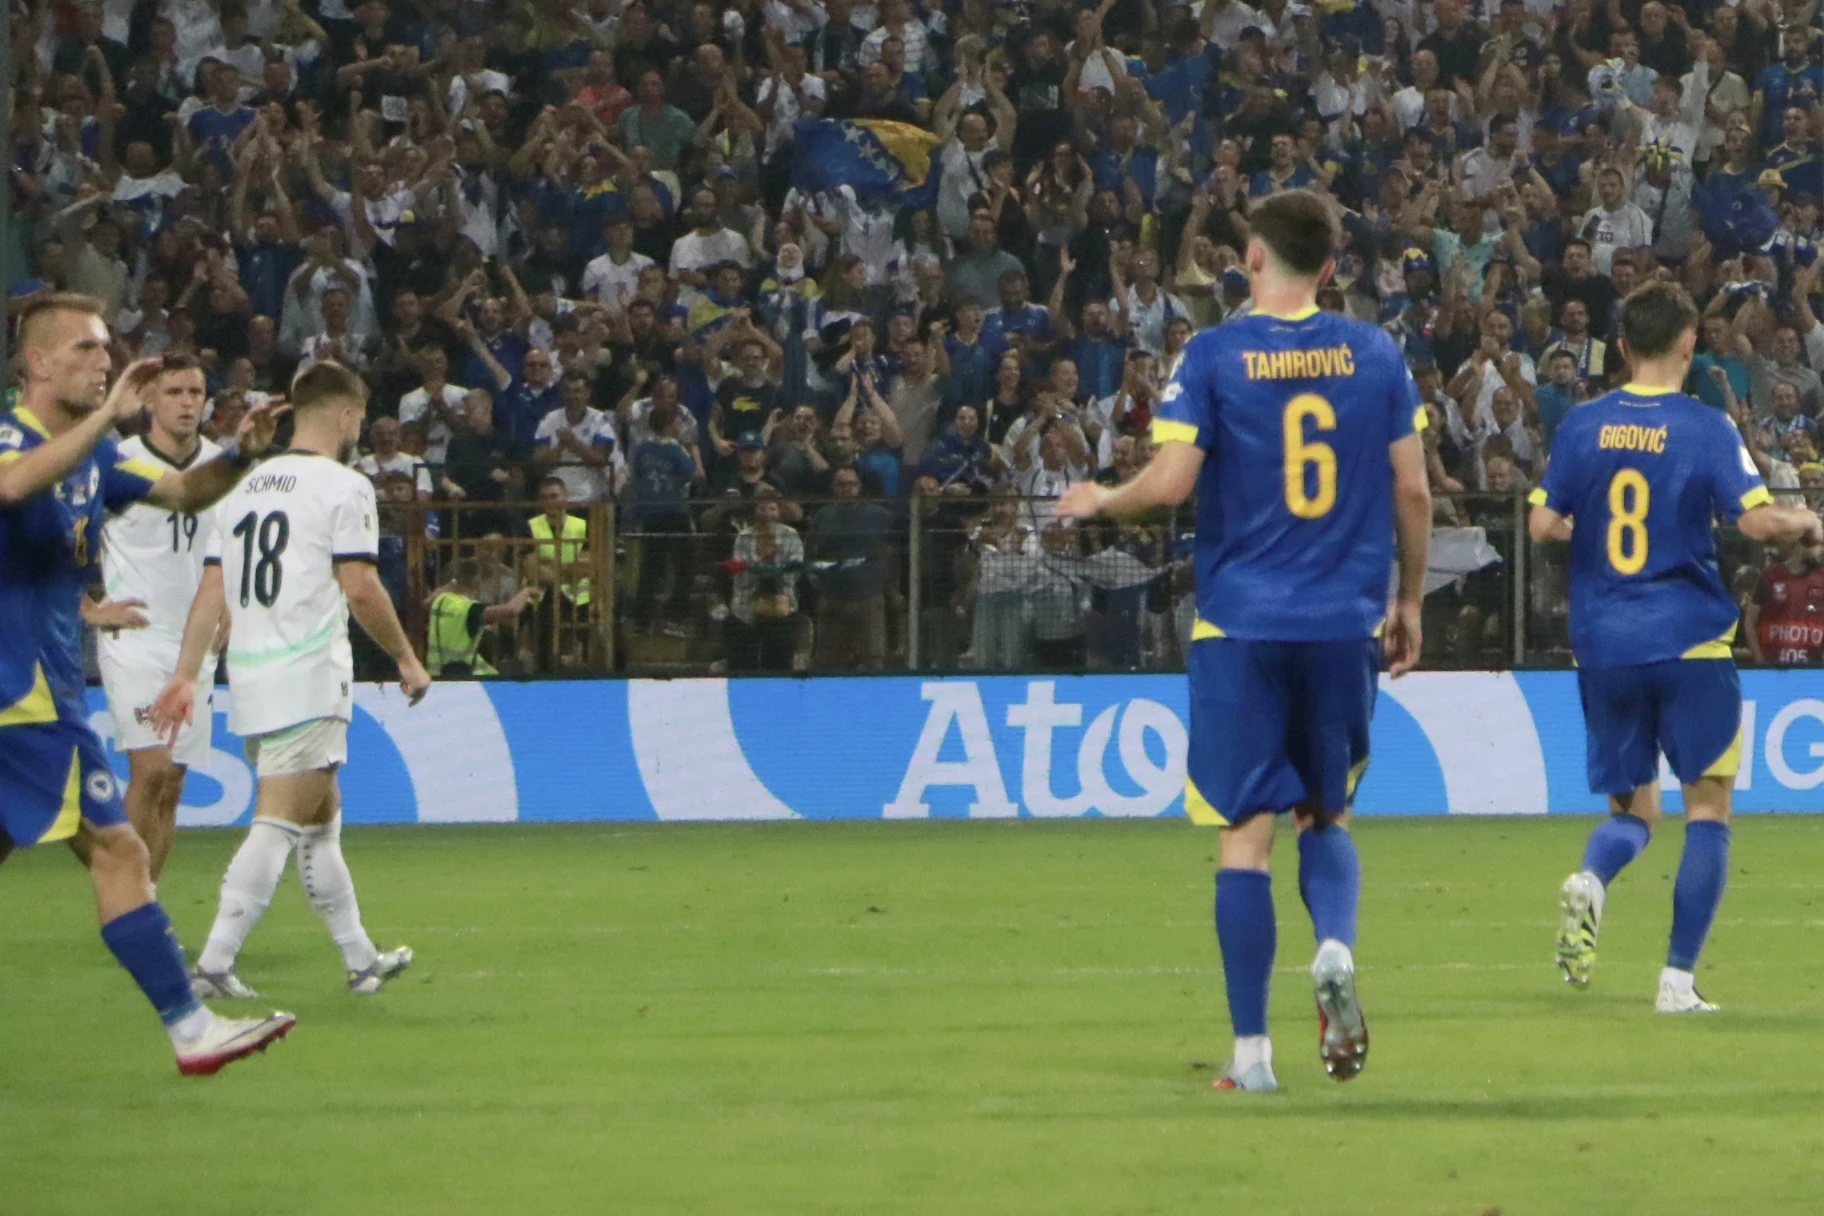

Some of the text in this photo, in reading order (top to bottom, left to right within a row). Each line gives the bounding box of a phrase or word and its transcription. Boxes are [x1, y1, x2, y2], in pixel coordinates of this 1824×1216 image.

[1242, 342, 1356, 380] TAHIROVIĆ
[1282, 392, 1337, 520] 6
[1599, 425, 1668, 454] GIGOVIĆ
[244, 474, 297, 494] SCHMID
[167, 511, 199, 553] 19
[1606, 468, 1650, 575] 8
[232, 510, 290, 609] 18
[1770, 624, 1824, 646] PHOTO
[882, 681, 1189, 819] Ato
